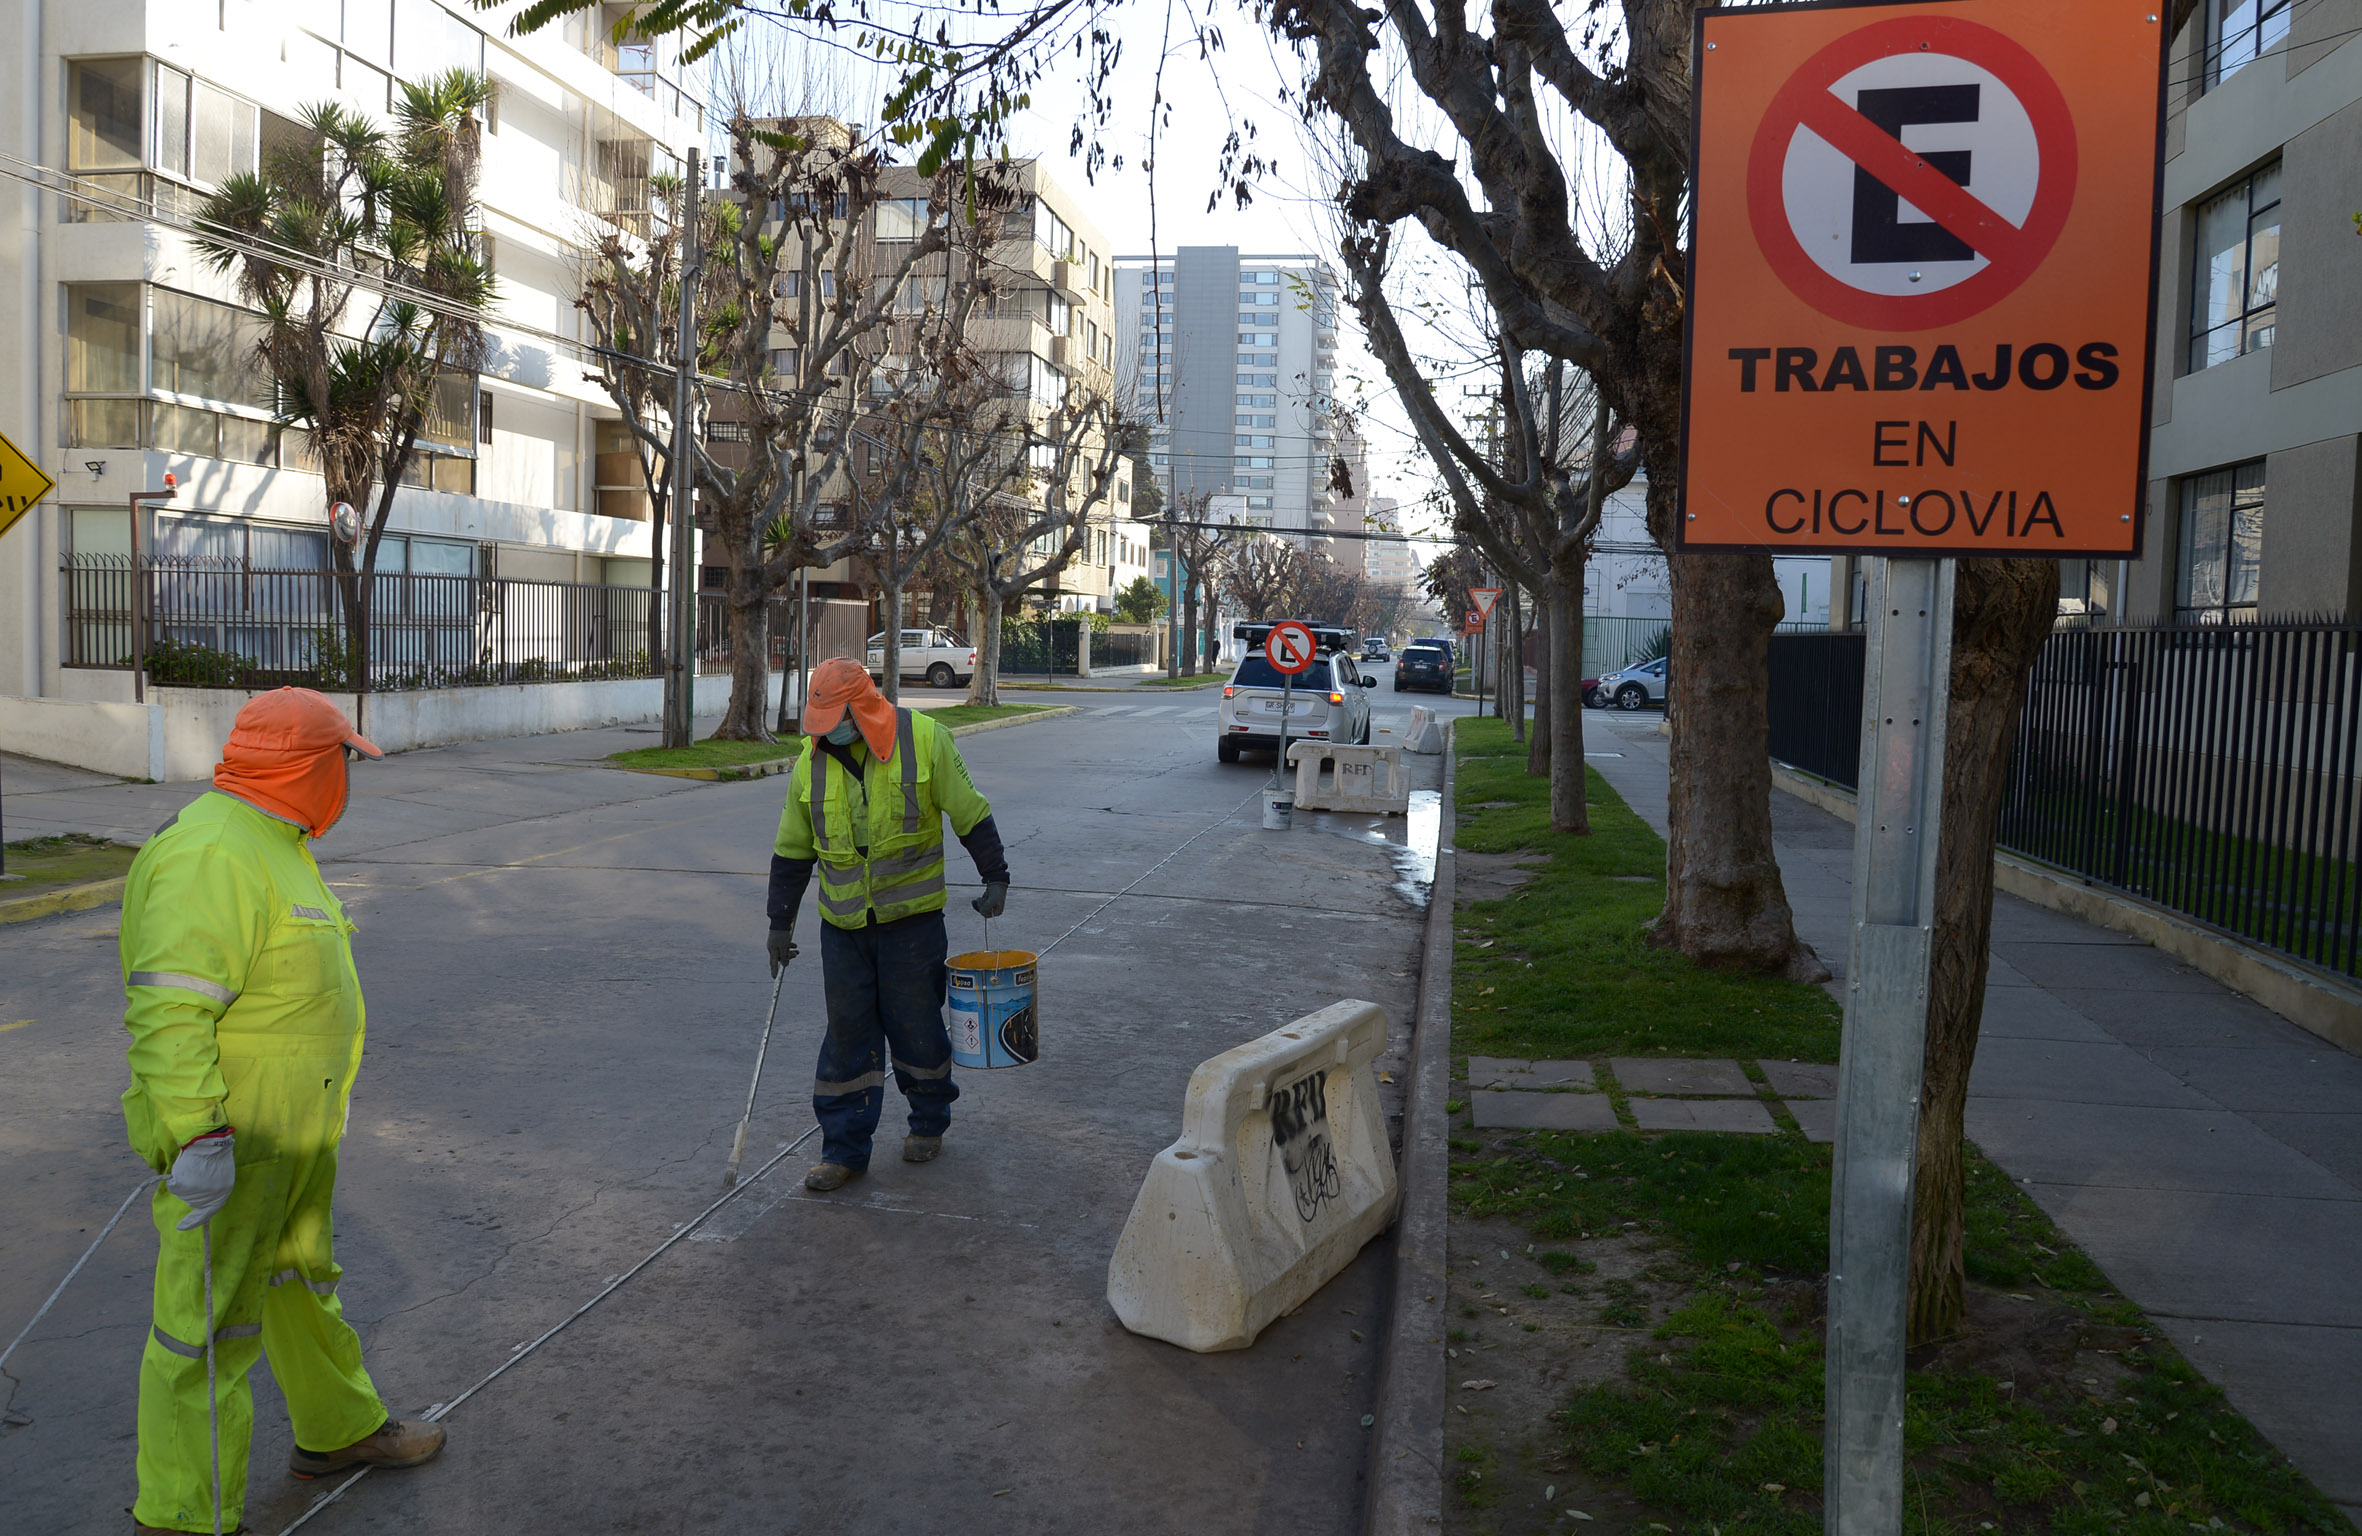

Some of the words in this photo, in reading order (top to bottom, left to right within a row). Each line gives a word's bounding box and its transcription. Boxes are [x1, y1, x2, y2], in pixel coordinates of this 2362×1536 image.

[1727, 342, 2120, 393] TRABAJOS
[1873, 420, 1957, 467] EN
[1765, 488, 2065, 538] CICLOVIA
